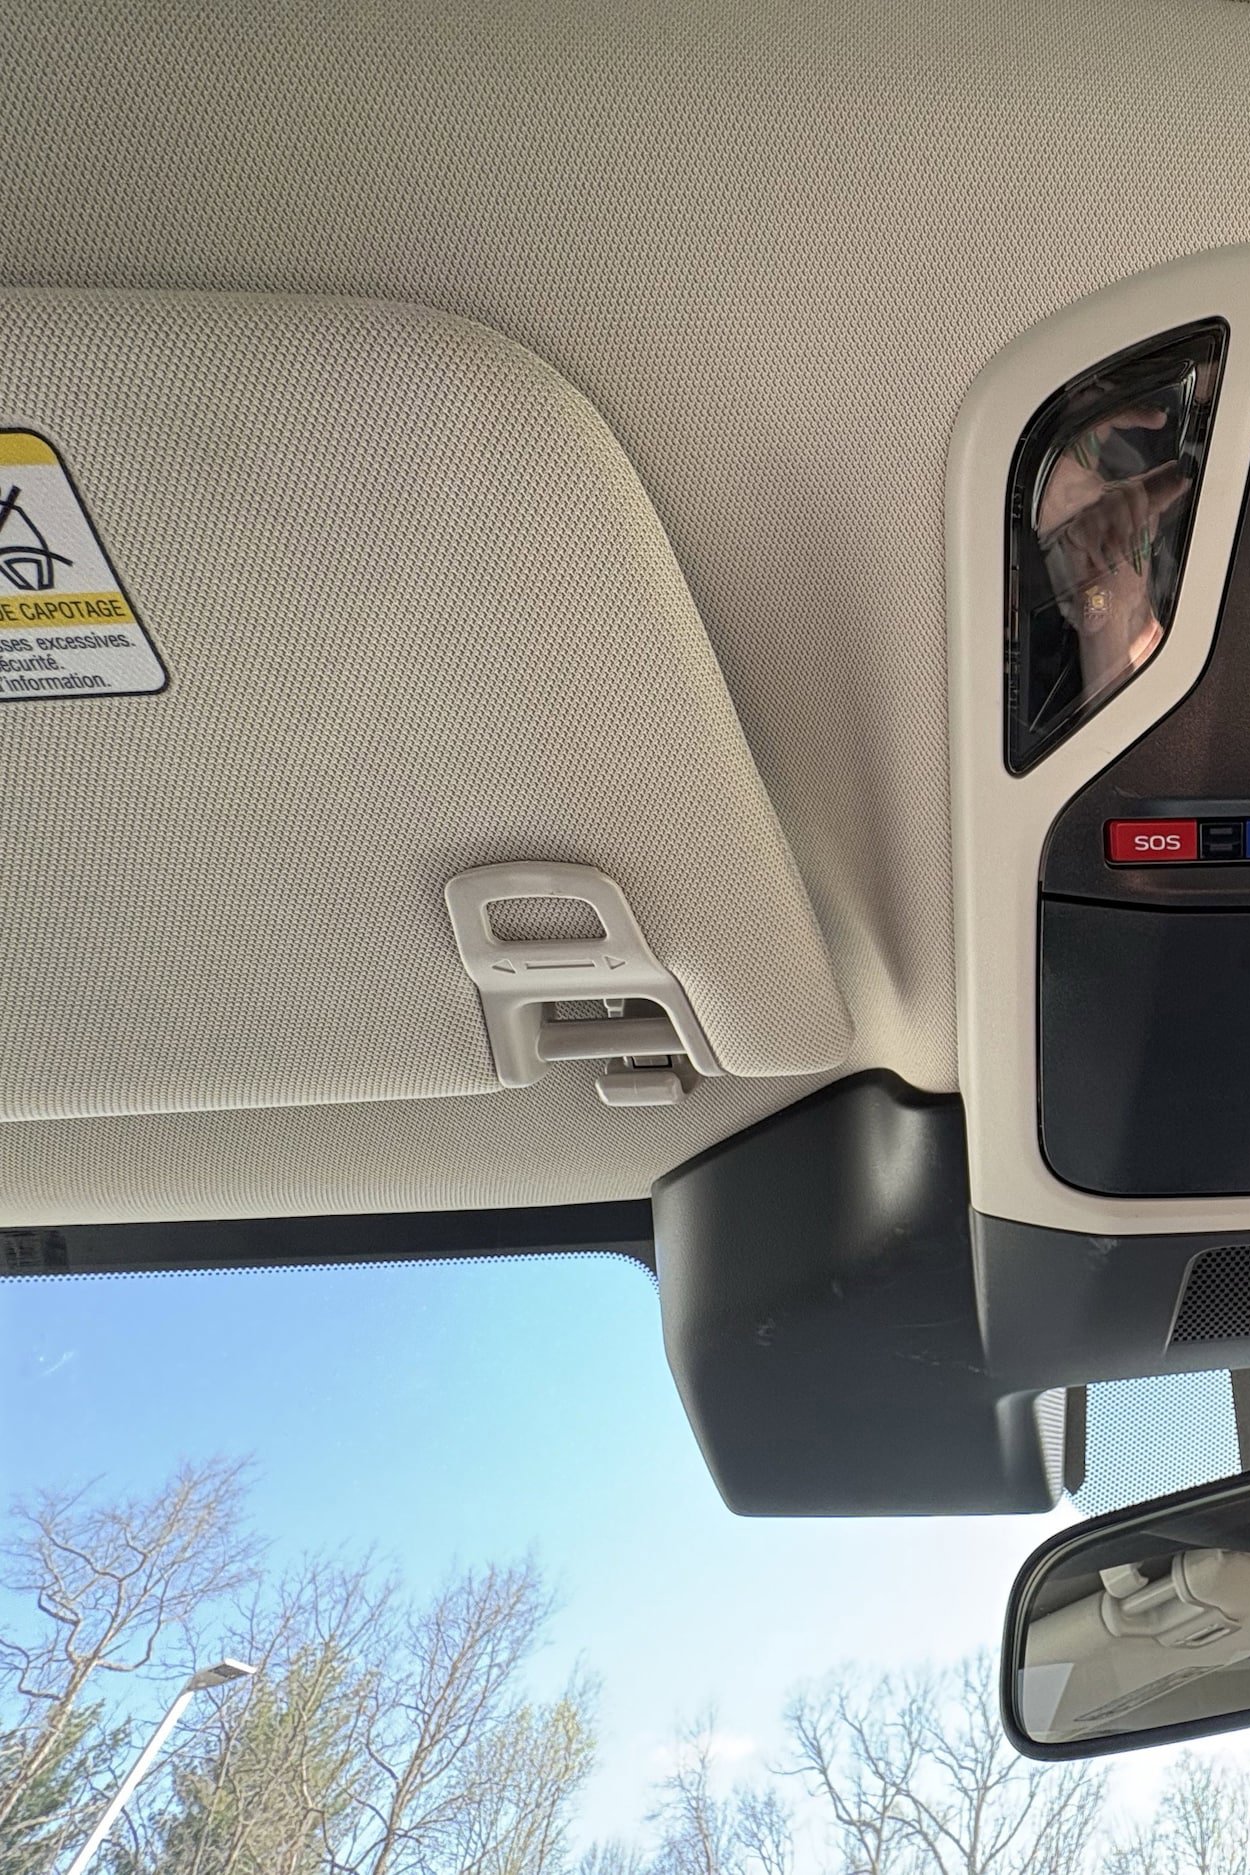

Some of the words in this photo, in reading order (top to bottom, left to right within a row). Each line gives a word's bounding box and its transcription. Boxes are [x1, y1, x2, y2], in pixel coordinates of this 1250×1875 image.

[20, 600, 126, 620] CAPOTAGE
[36, 632, 136, 651] excessives.
[0, 654, 65, 673] écurité.
[1134, 835, 1181, 851] SOS
